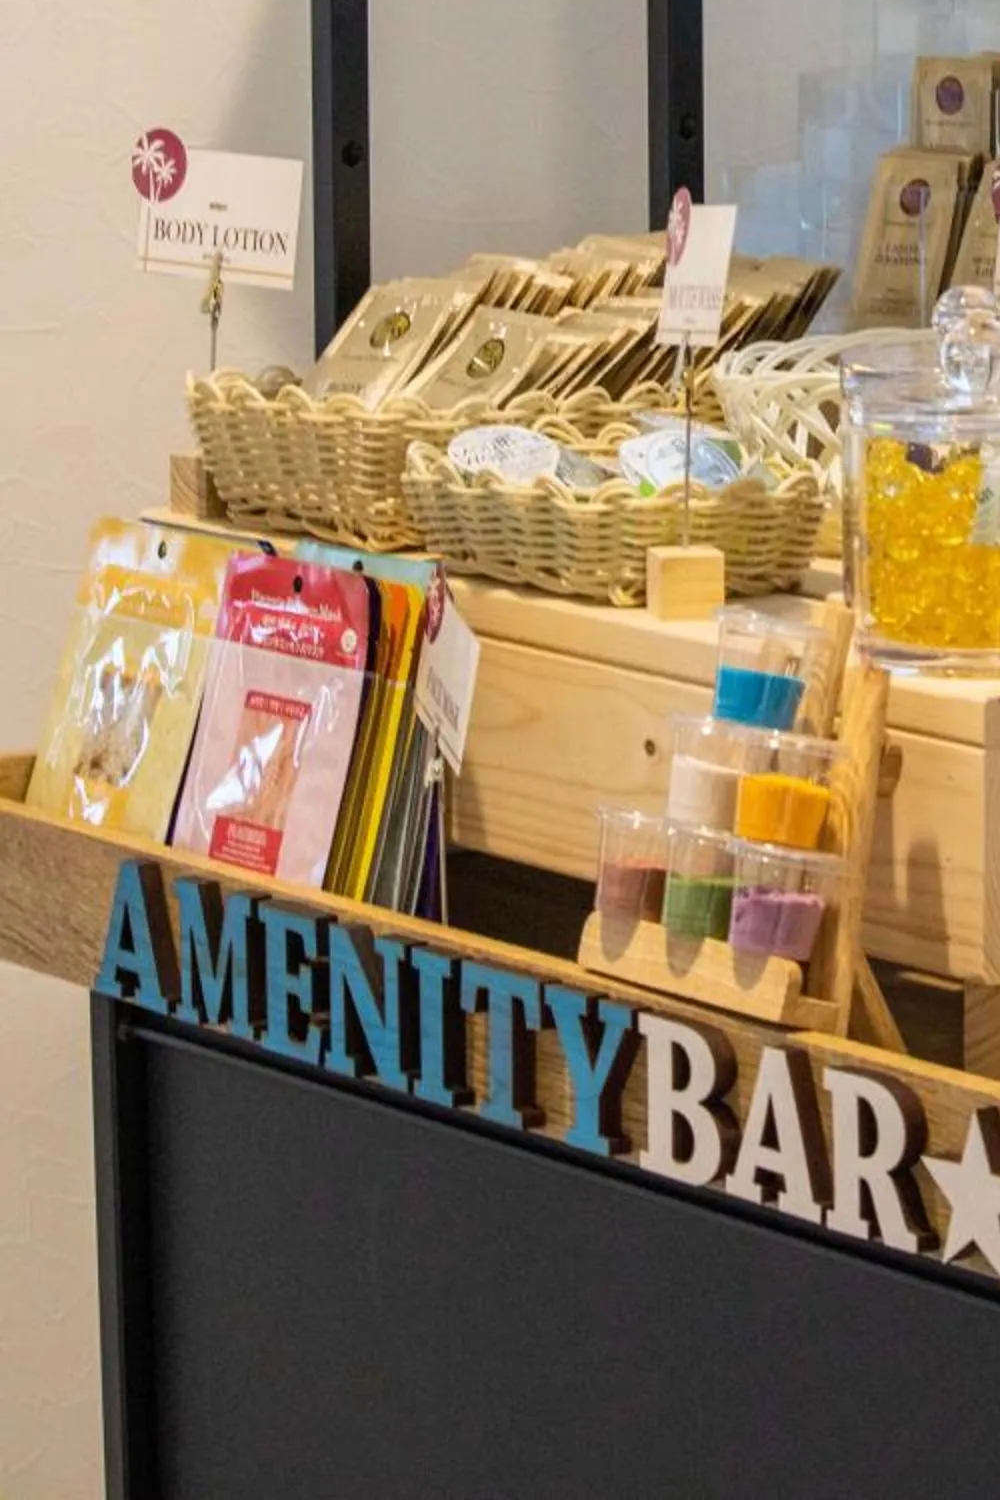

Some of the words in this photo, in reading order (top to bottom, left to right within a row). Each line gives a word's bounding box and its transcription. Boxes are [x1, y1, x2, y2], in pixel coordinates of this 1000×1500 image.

[153, 218, 209, 246] BODY
[211, 224, 290, 257] LOTION
[93, 858, 640, 1158] AMENITY
[635, 1010, 925, 1258] BAR
